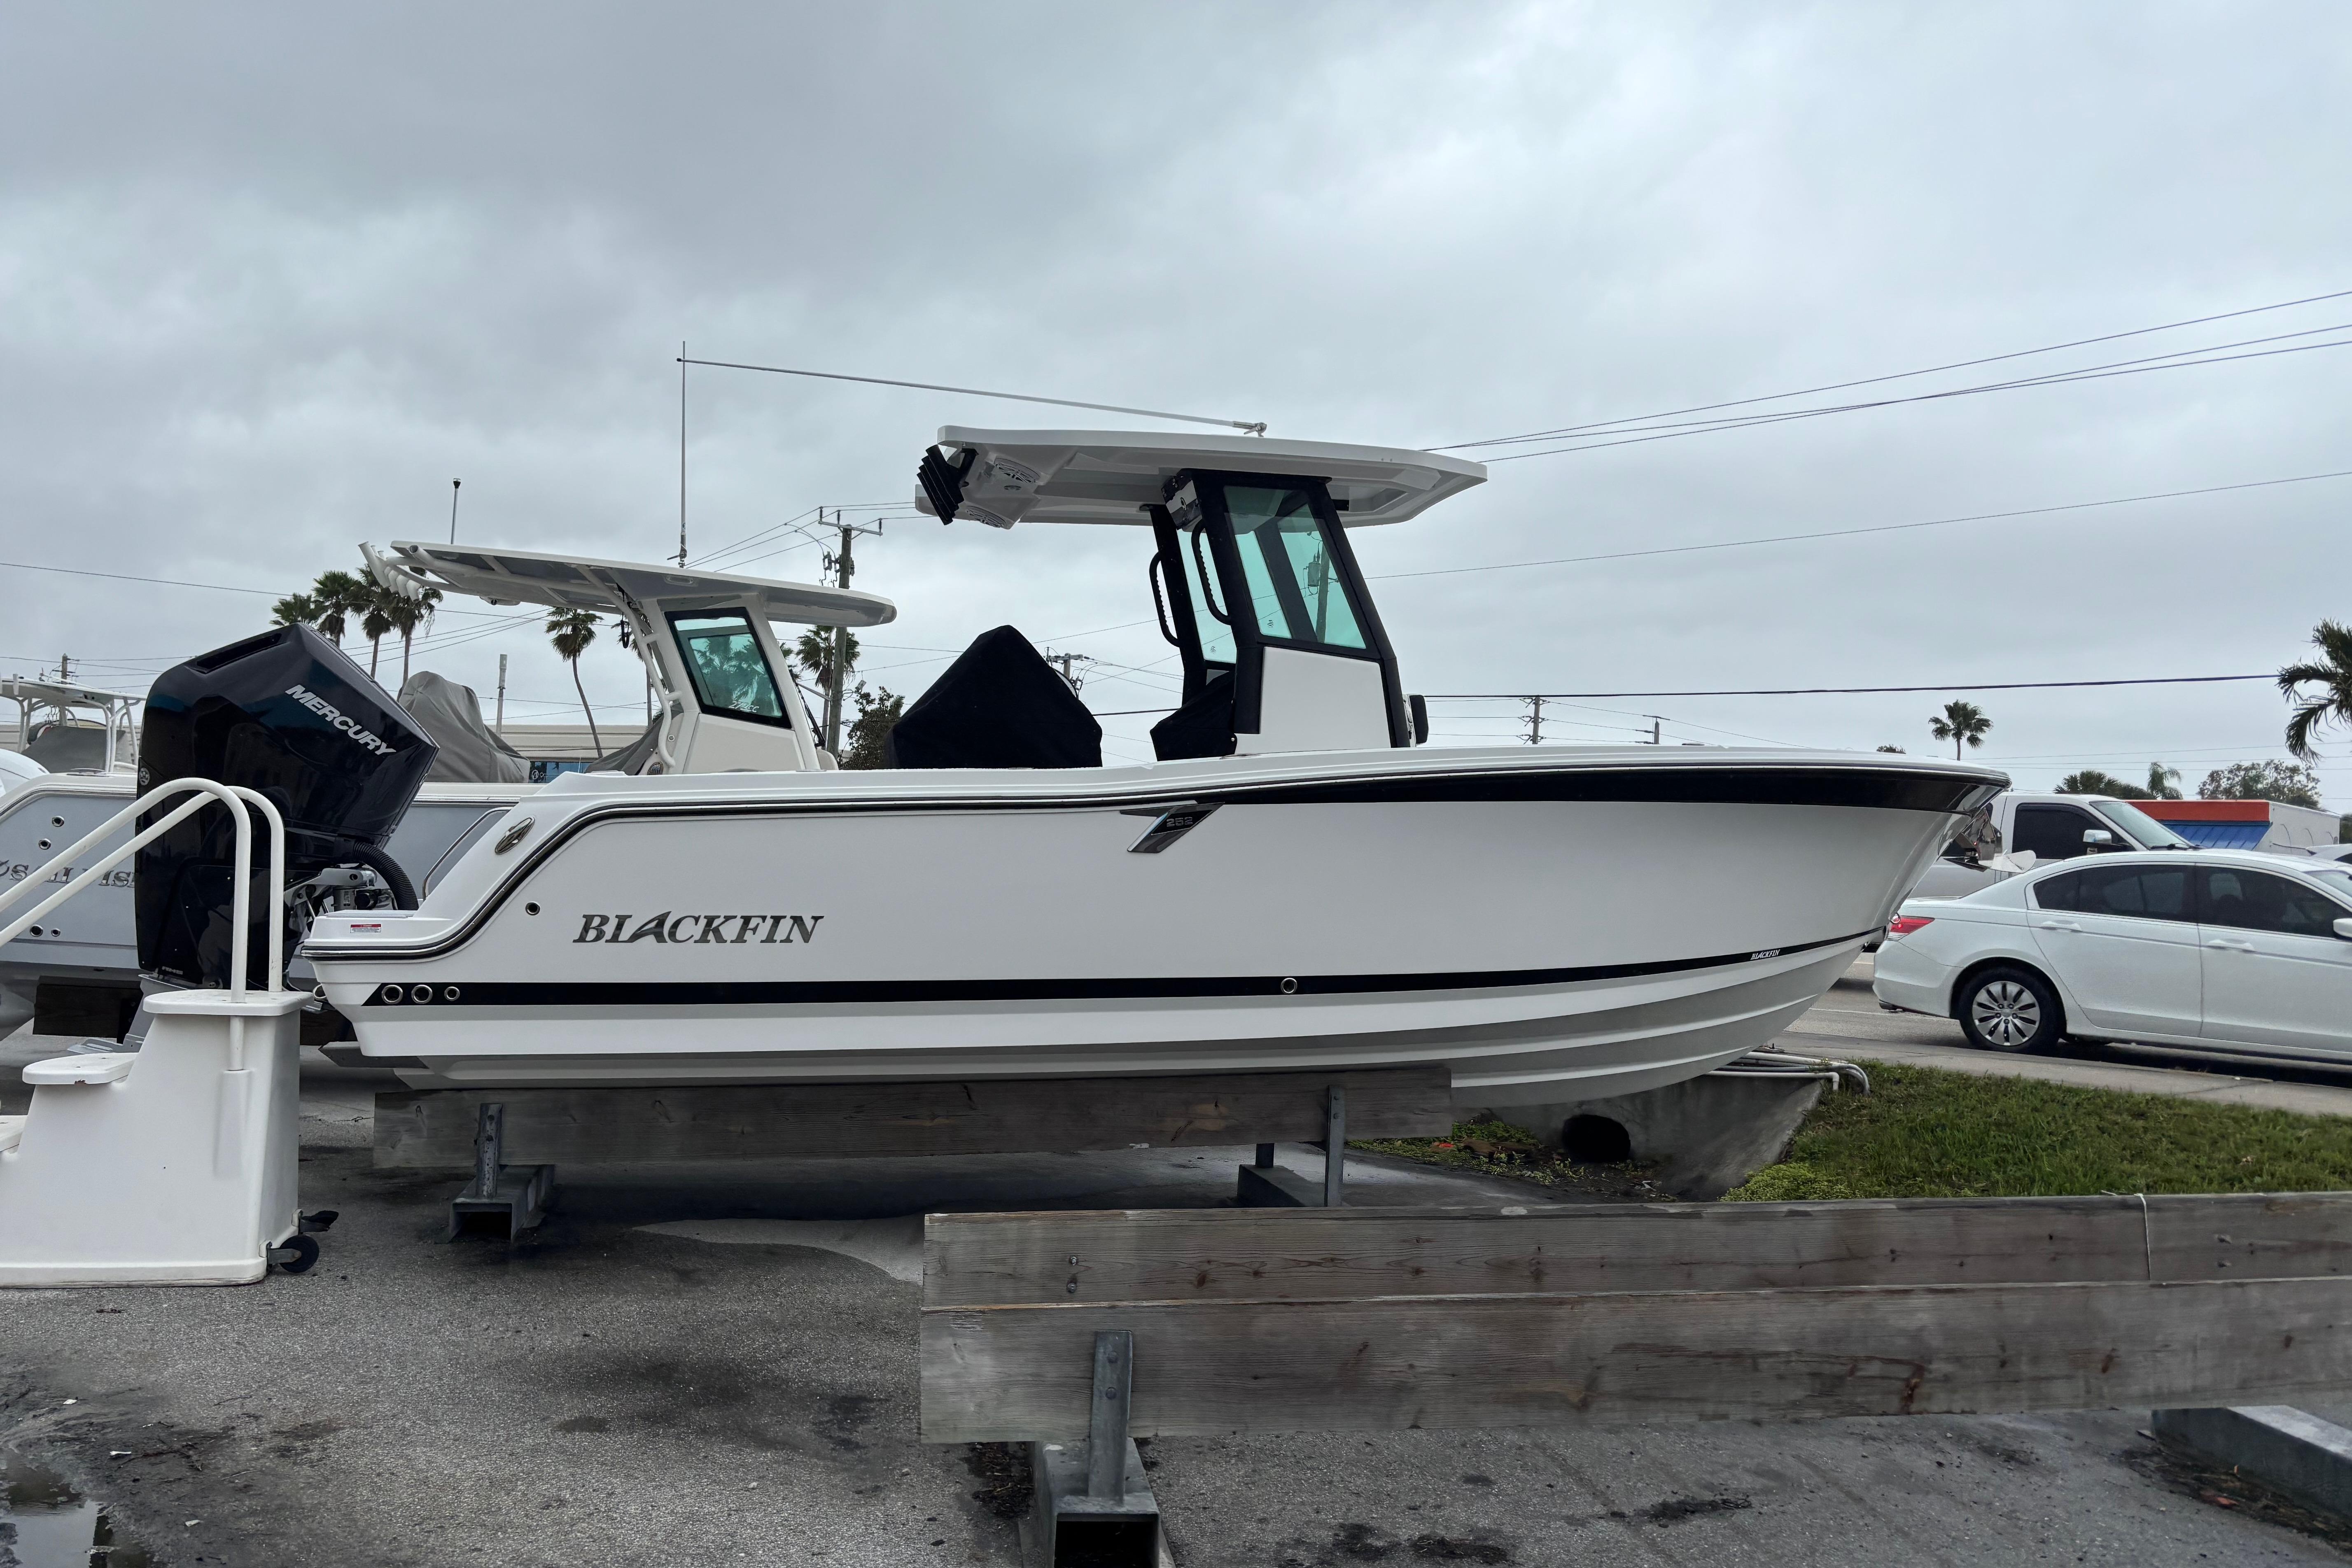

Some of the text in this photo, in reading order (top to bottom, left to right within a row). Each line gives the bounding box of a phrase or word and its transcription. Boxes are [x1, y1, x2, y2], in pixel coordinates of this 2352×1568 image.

[285, 684, 397, 755] MERCURY
[1167, 817, 1193, 827] 252
[572, 911, 825, 943] BLACKFIN
[1750, 949, 1780, 960] BLACKFIN
